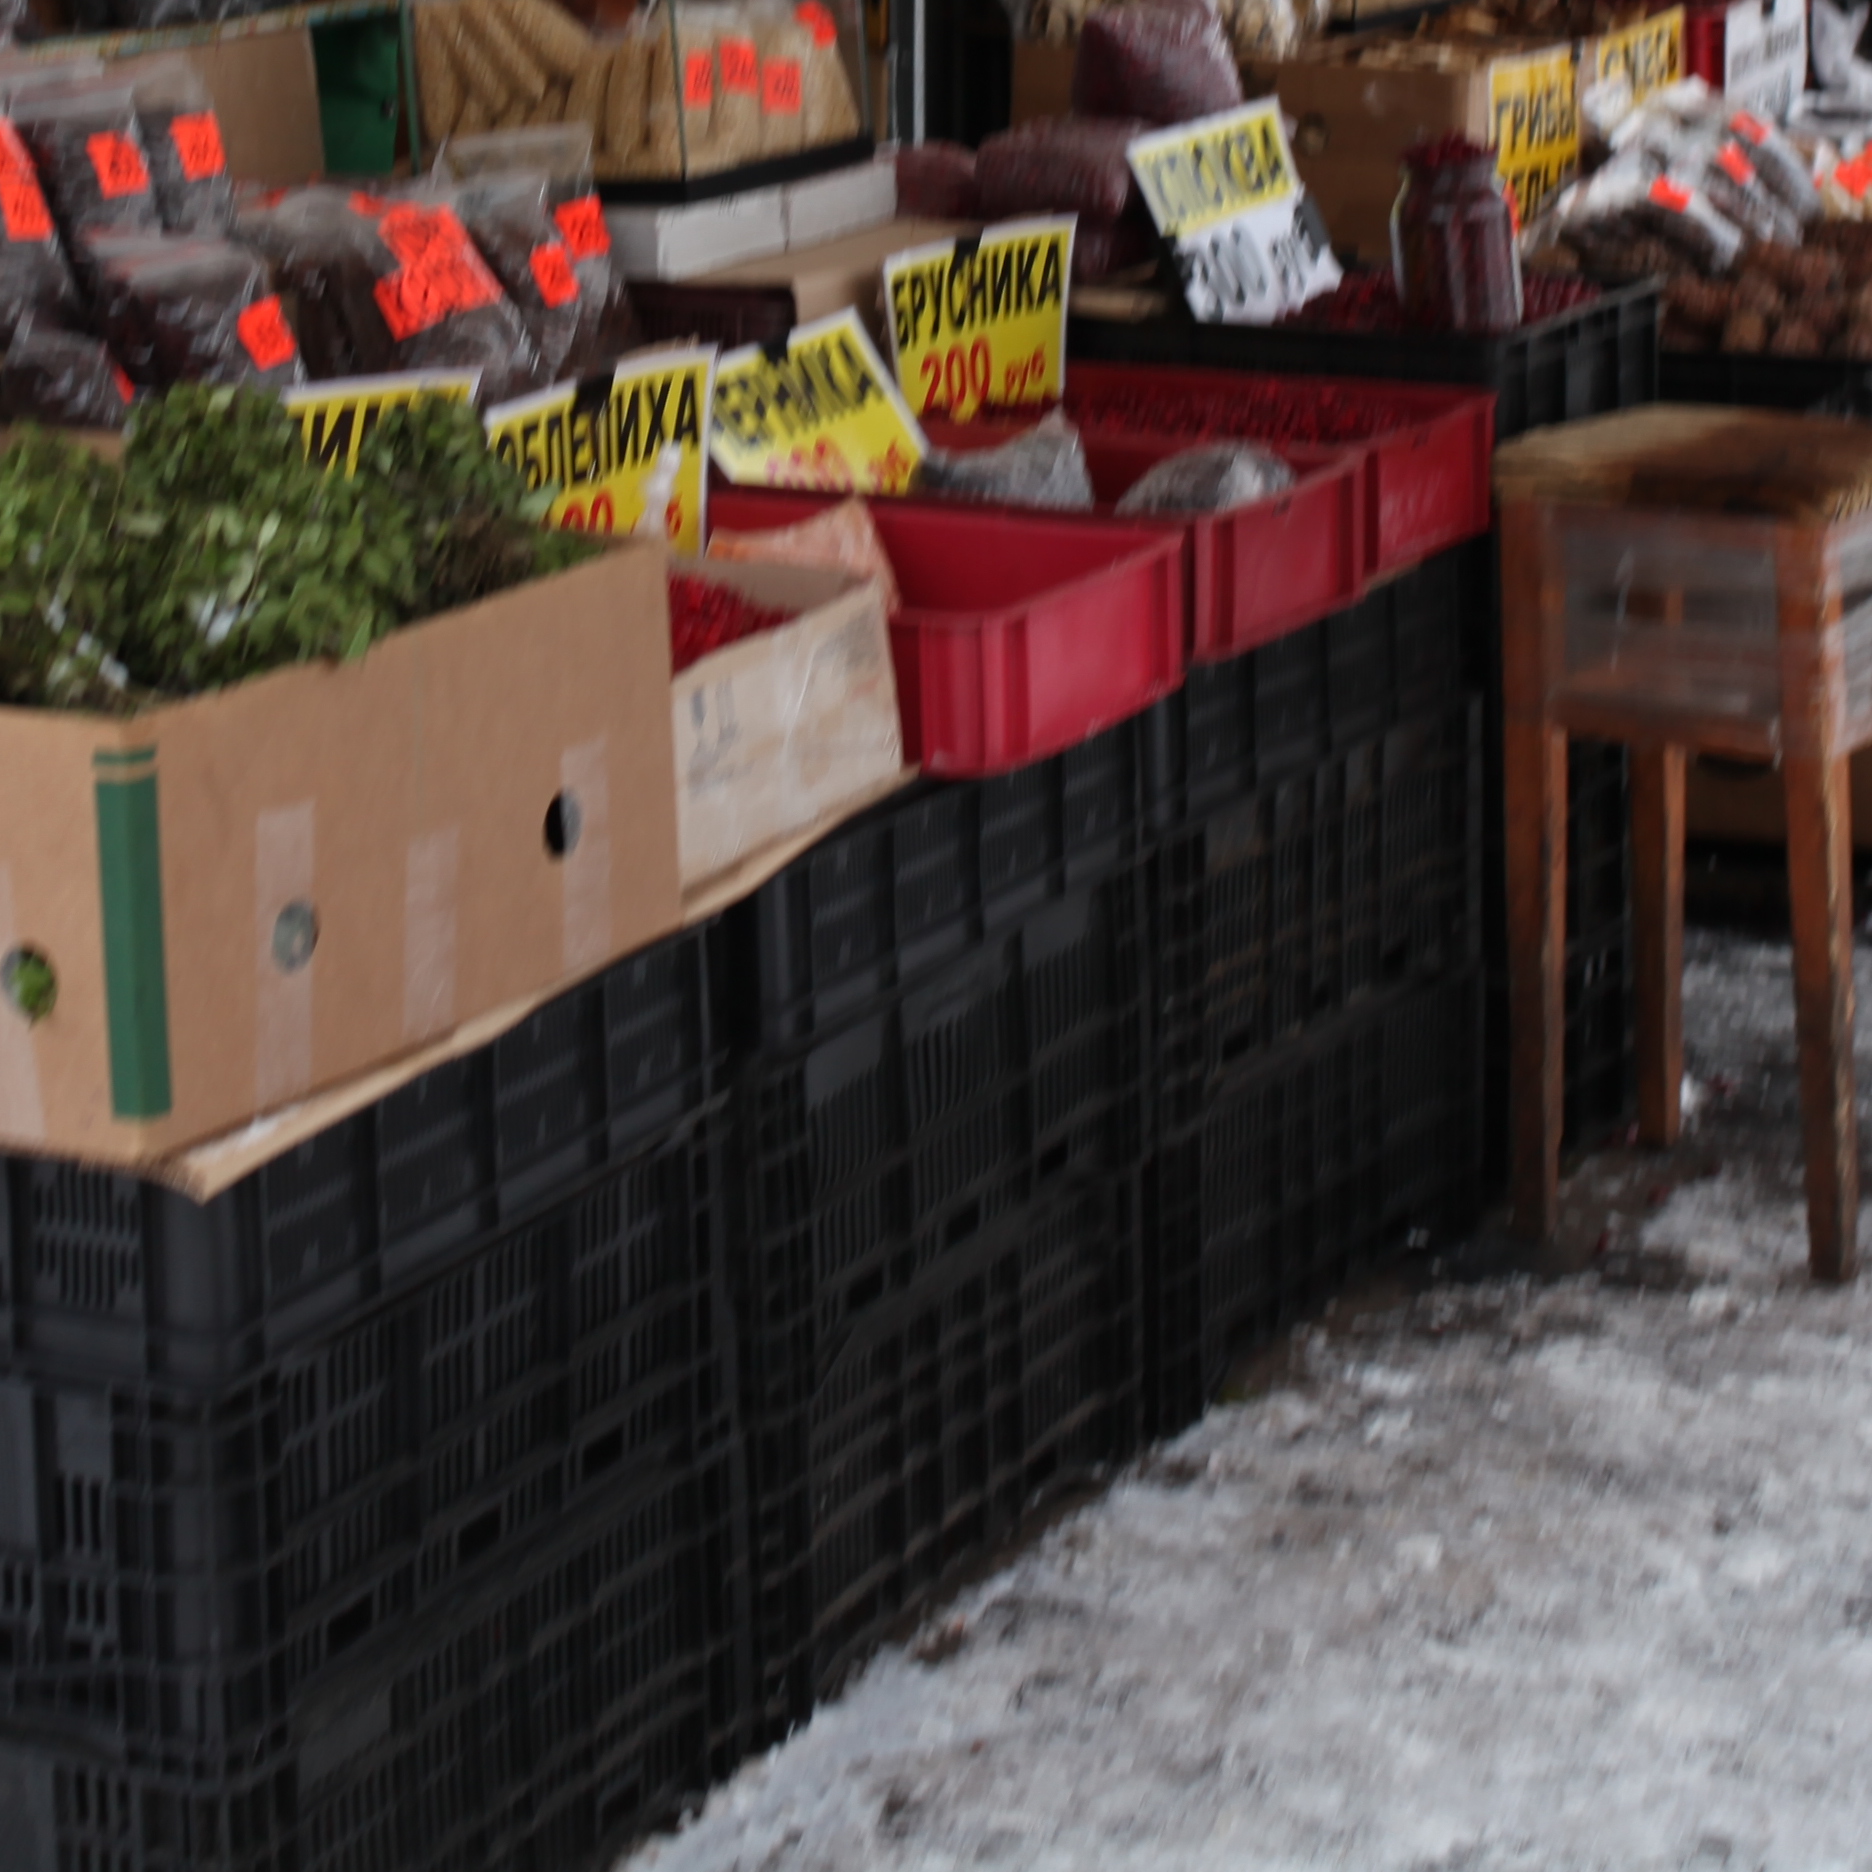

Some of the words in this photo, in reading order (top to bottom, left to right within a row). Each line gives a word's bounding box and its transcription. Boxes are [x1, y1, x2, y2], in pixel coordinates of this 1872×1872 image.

[891, 239, 1062, 357] БРУСНИКА
[713, 336, 885, 452] ЕРНИКА
[919, 334, 991, 415] 200
